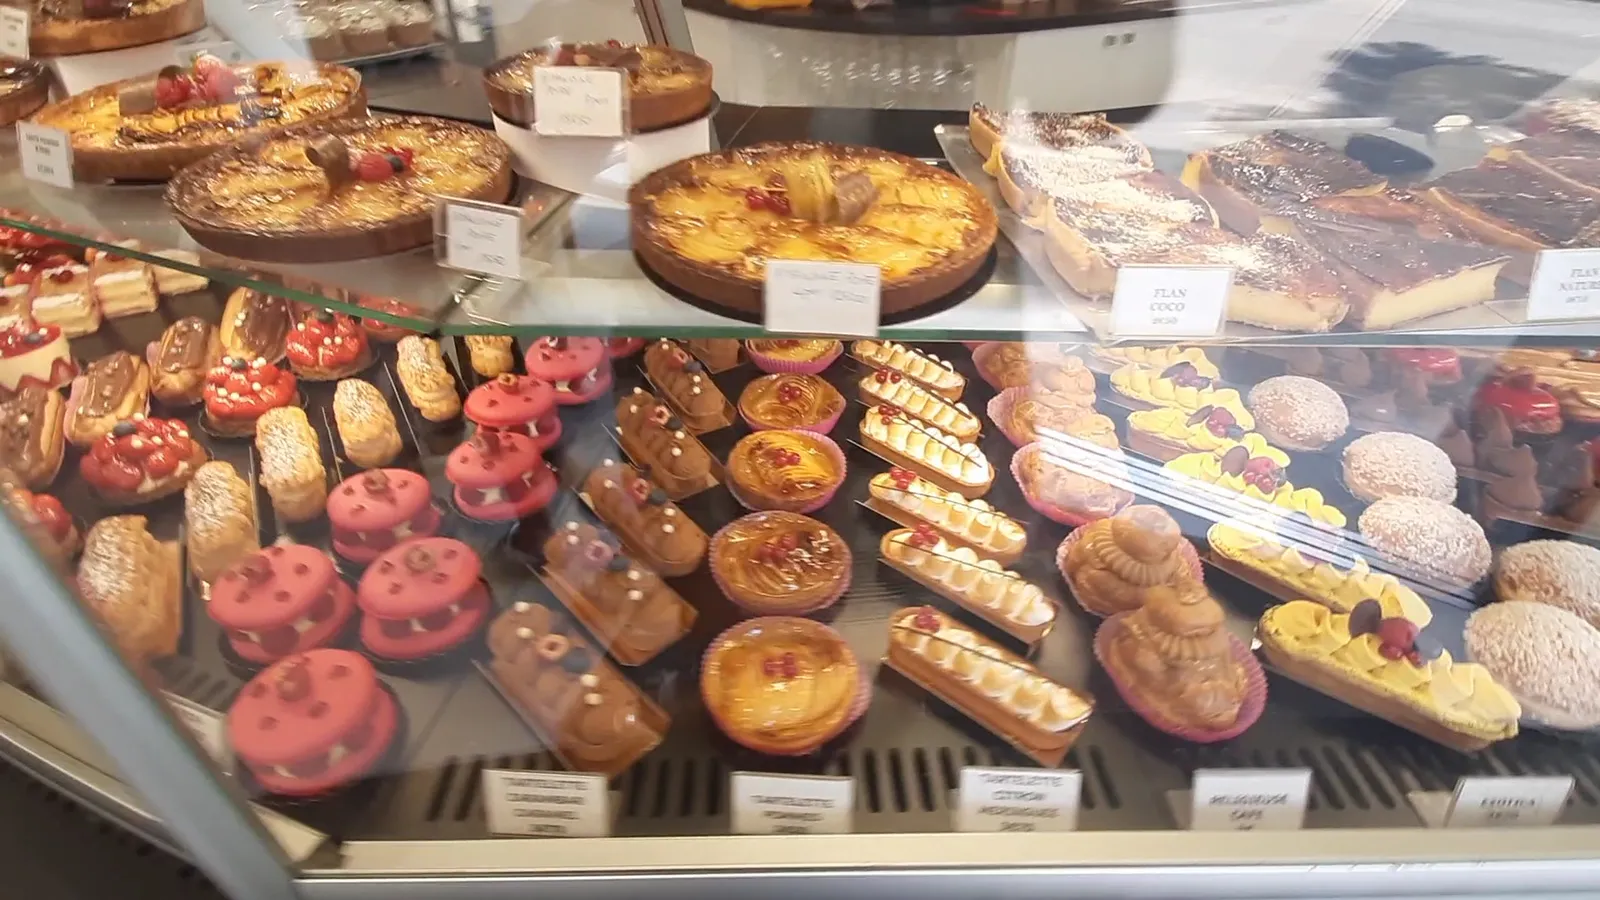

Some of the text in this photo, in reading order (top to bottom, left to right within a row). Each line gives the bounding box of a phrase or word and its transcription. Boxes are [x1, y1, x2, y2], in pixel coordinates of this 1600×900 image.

[1558, 281, 1600, 291] NATUR
[1153, 288, 1188, 298] FLAN
[1149, 302, 1185, 312] COCO
